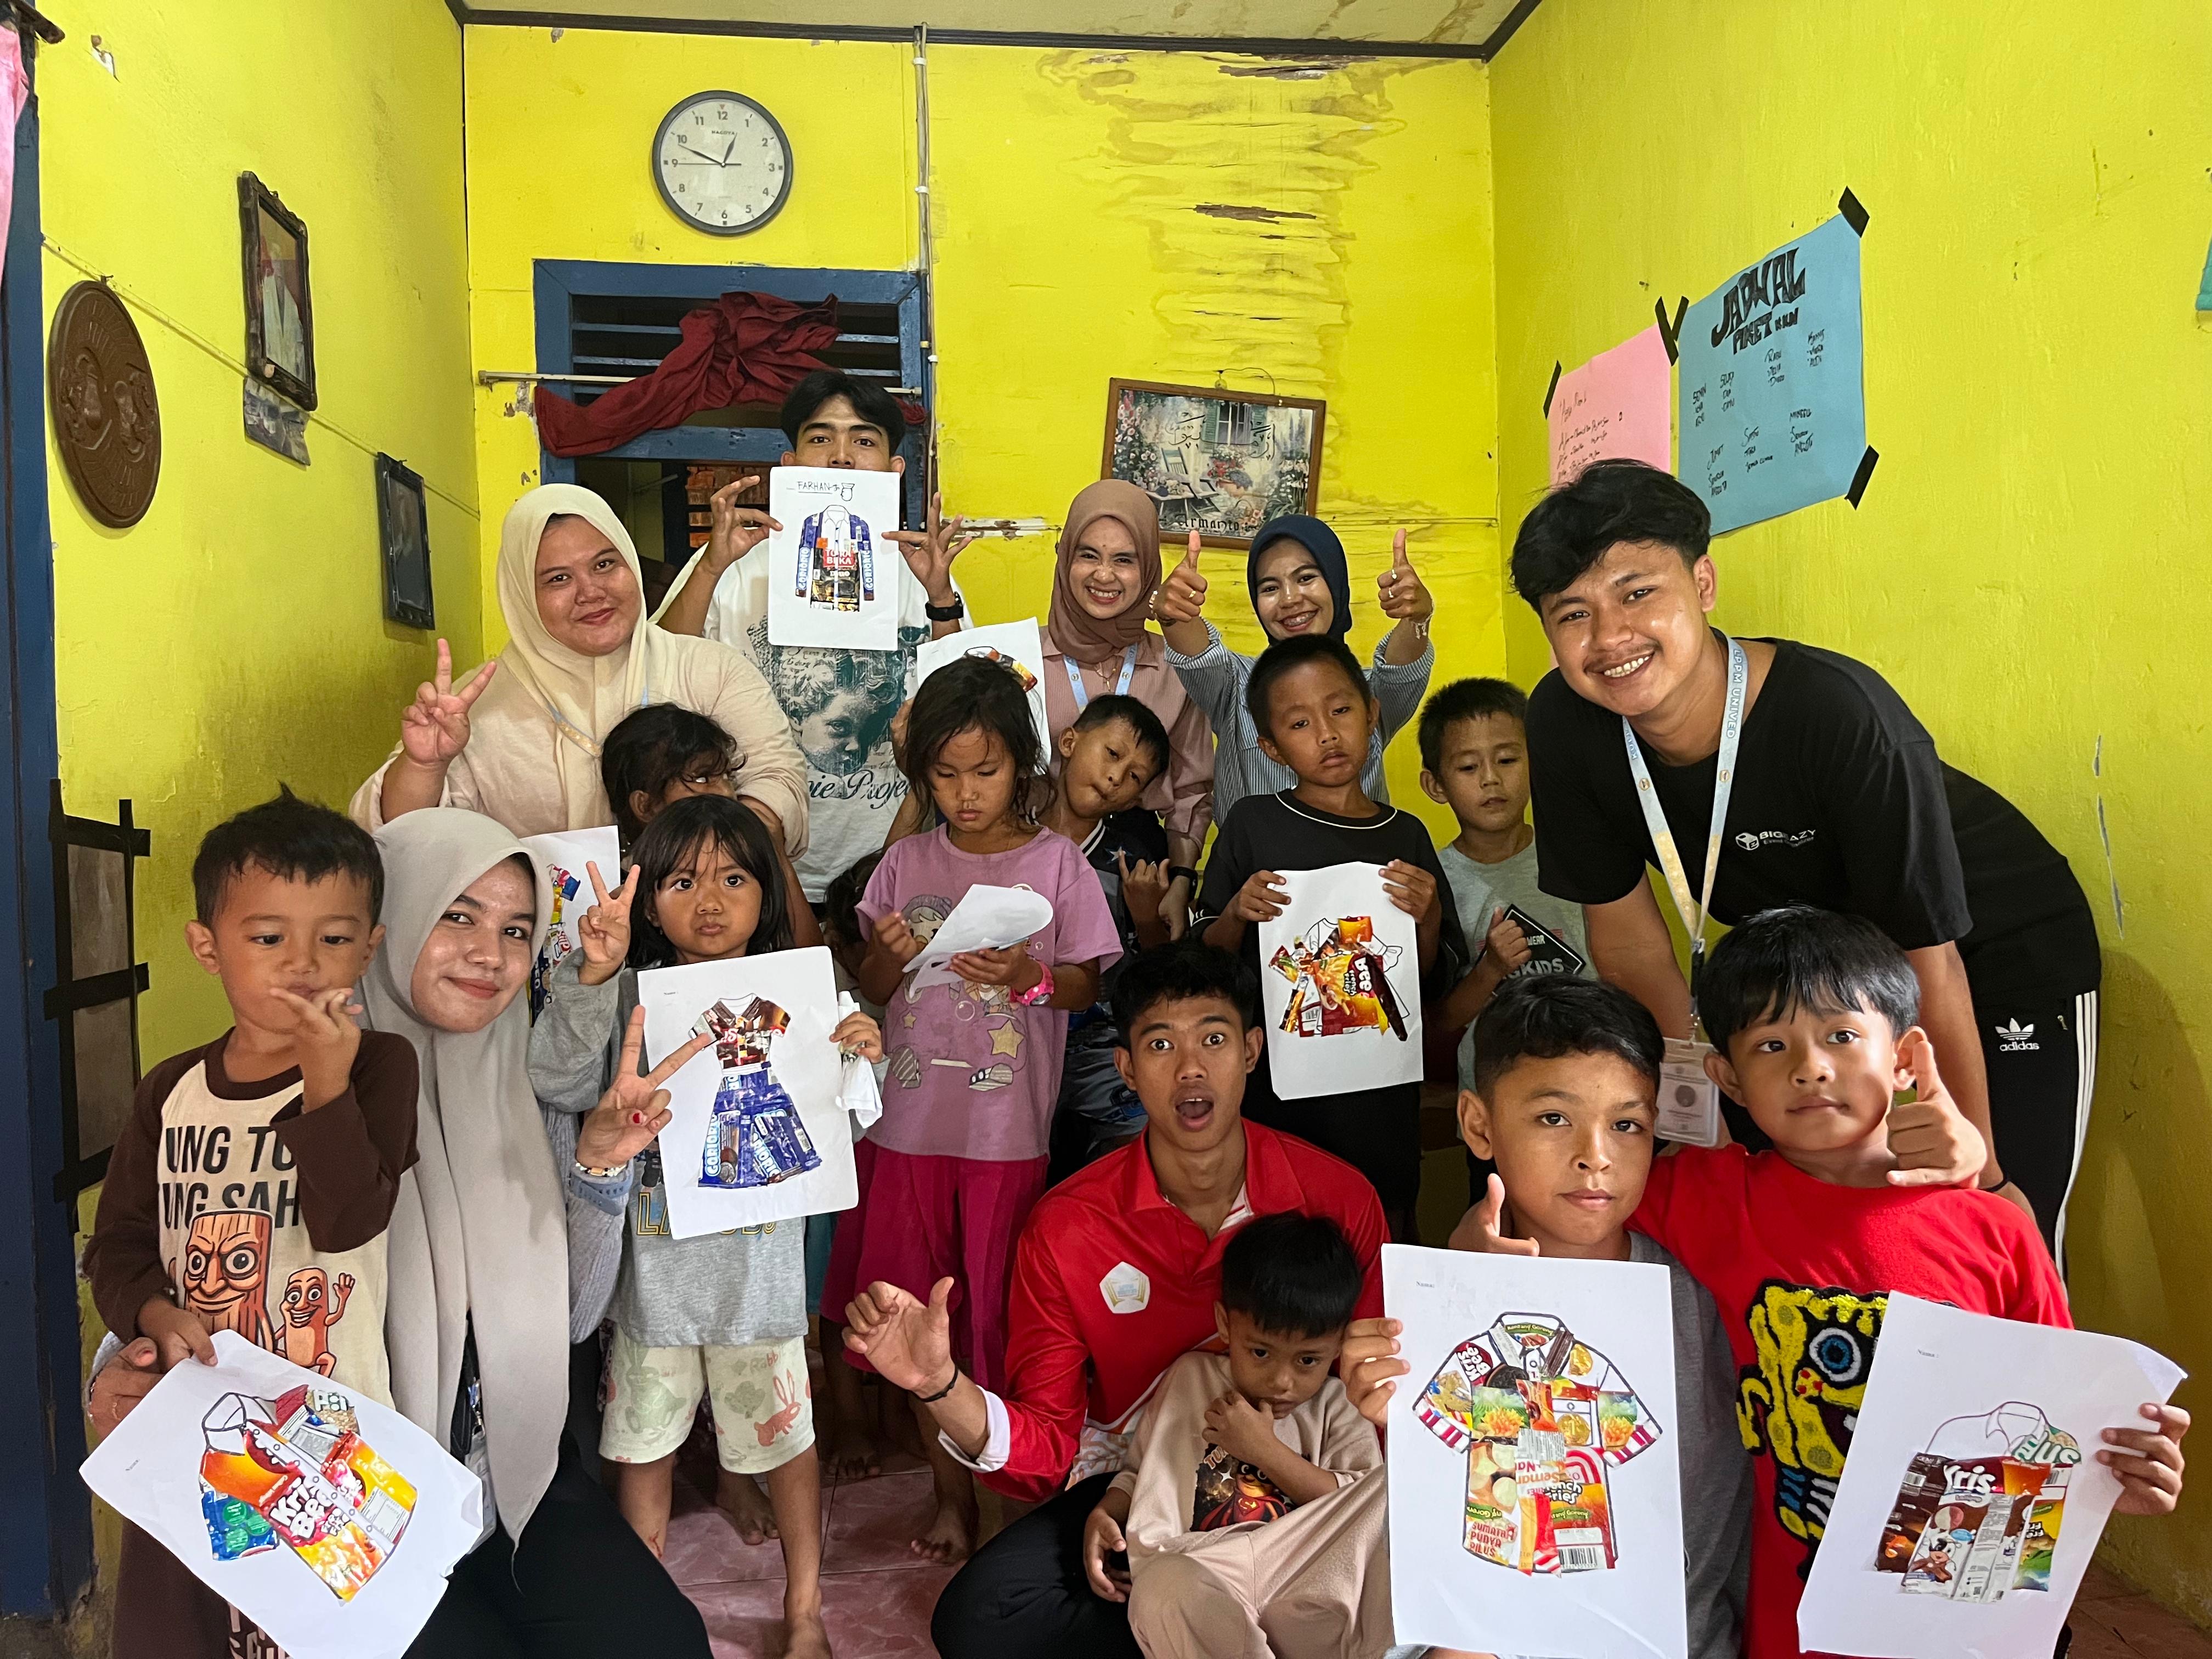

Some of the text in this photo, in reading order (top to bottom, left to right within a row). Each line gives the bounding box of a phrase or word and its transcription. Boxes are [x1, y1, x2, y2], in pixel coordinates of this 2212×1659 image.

[717, 111, 728, 121] 12
[695, 116, 704, 126] 11
[744, 119, 749, 128] 1
[677, 134, 687, 144] 10
[761, 138, 769, 147] 2
[672, 159, 678, 167] 9
[768, 163, 775, 172] 3
[679, 184, 686, 193] 8
[763, 187, 769, 196] 4
[697, 202, 703, 211] 7
[745, 204, 752, 213] 5
[721, 210, 727, 219] 6
[797, 481, 831, 492] FARHAN
[1726, 649, 1743, 738] LPPM UNIVED
[1526, 935, 1545, 946] WEAR
[2000, 1041, 2040, 1052] adidas
[166, 1125, 232, 1174] UNG
